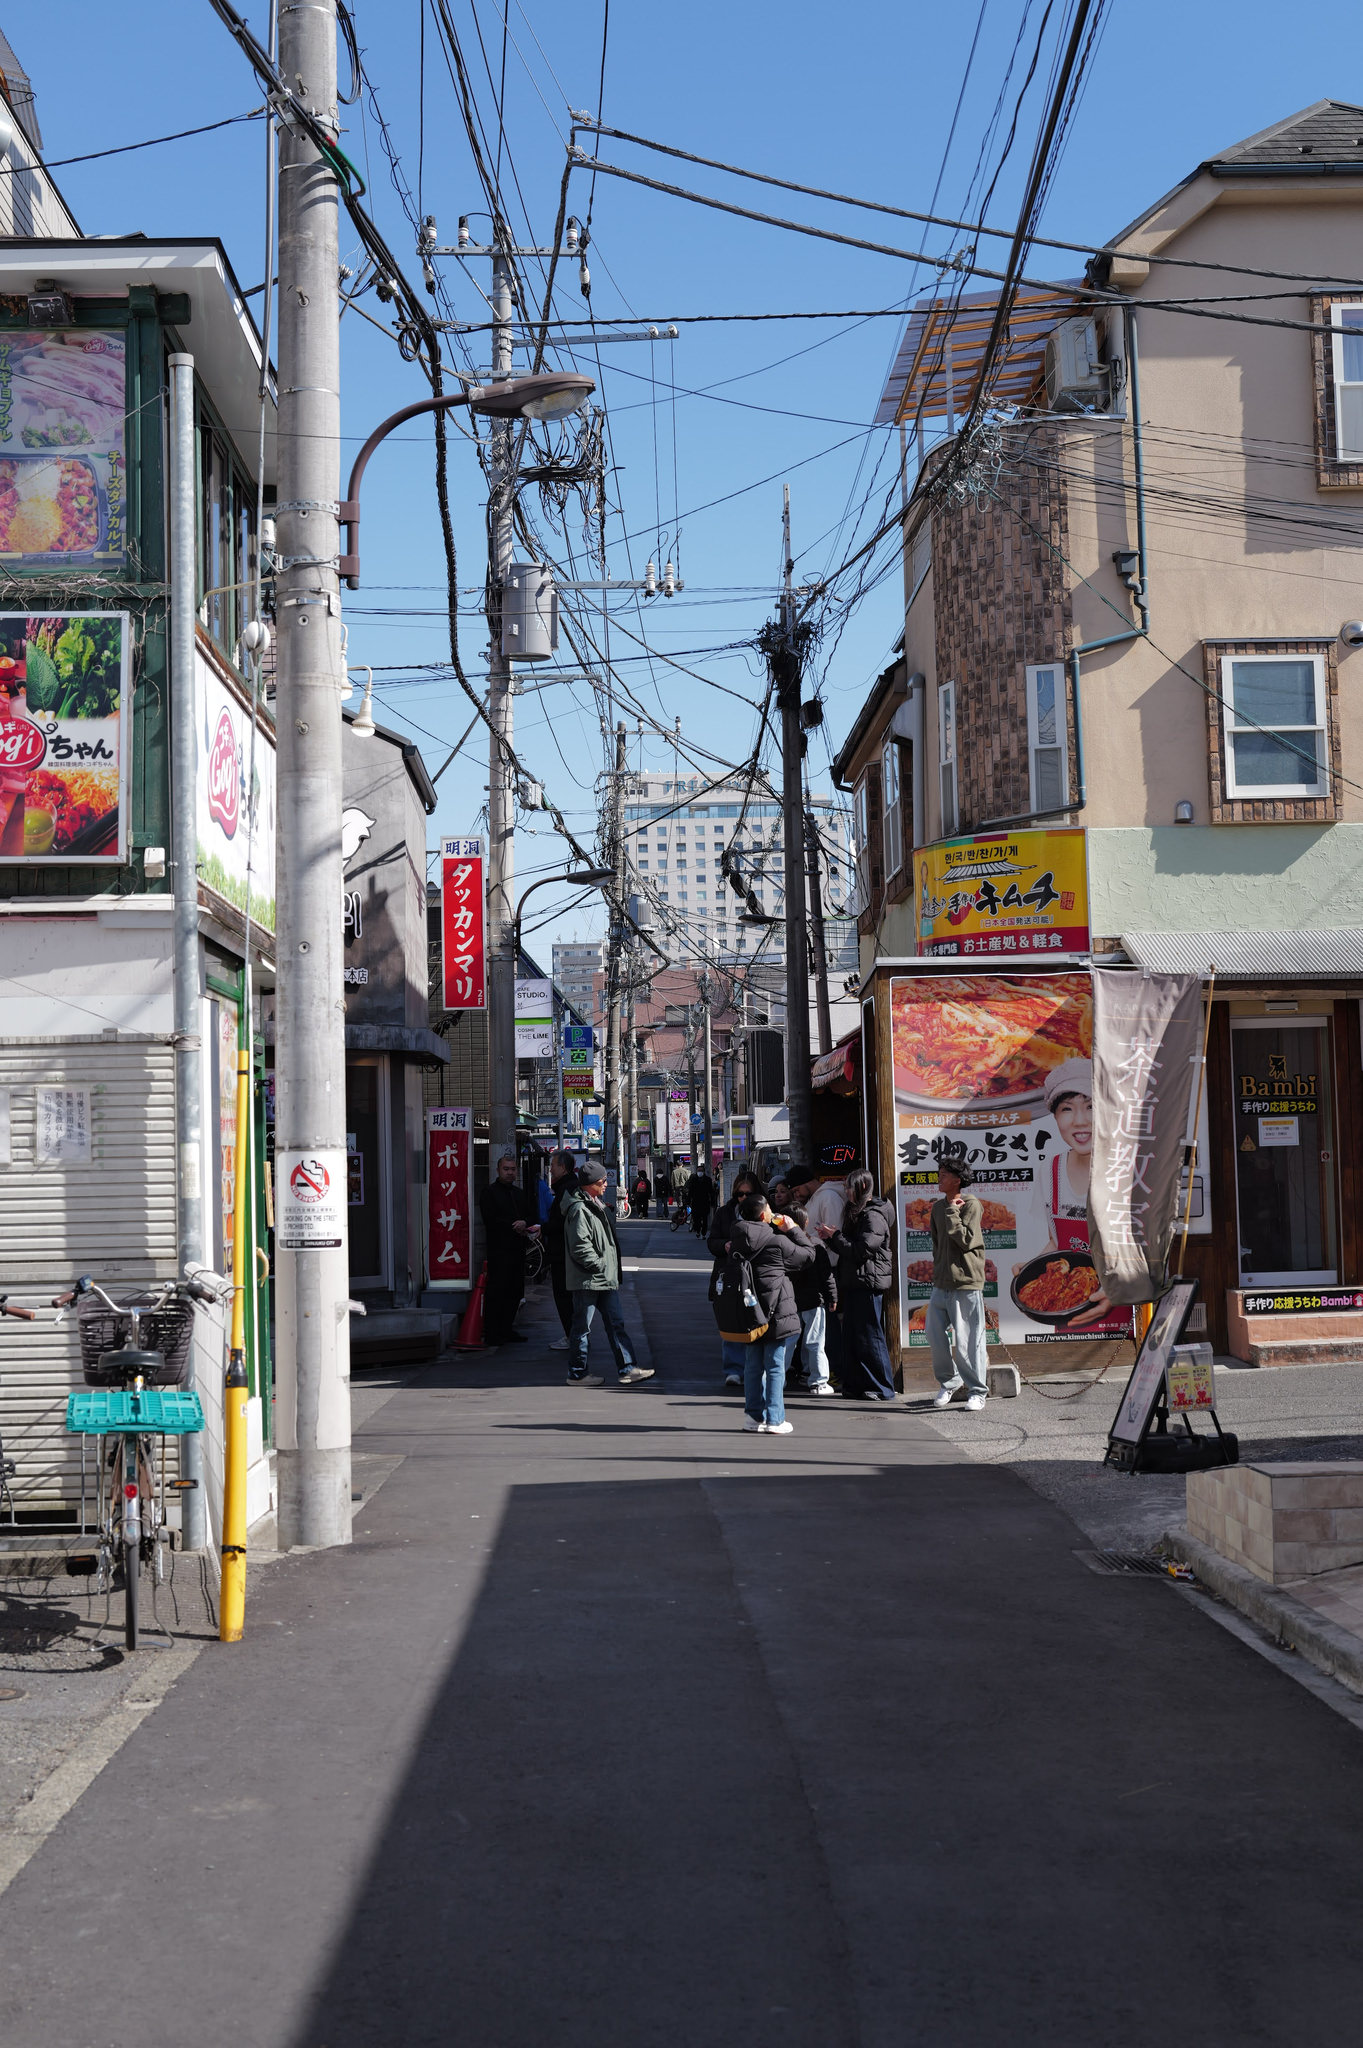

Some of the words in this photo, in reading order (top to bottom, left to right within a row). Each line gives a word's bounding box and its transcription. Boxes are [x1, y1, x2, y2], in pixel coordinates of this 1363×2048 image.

[107, 450, 121, 553] チーズタッカルビ
[48, 735, 114, 760] ちゃん
[445, 840, 480, 855] 明洞
[944, 845, 1018, 864] 한/국/반/찬/가/게
[980, 915, 1054, 928] 「日本全国発送可能」
[452, 863, 475, 1001] タッカンマリ
[572, 1028, 583, 1042] P
[571, 1049, 587, 1065] 空
[1241, 1076, 1317, 1097] Bambi
[1242, 1101, 1316, 1113] 手作り応援うちわ
[433, 1113, 466, 1128] 明洞
[911, 1113, 1020, 1127] 大阪鶴橋オモニキムチ
[1106, 1037, 1164, 1247] 茶道教室
[437, 1143, 461, 1264] ポッサム
[1246, 1296, 1353, 1310] 手作り応援うちわBambi
[1027, 1332, 1124, 1342] http://www.kimuchisuki.com
